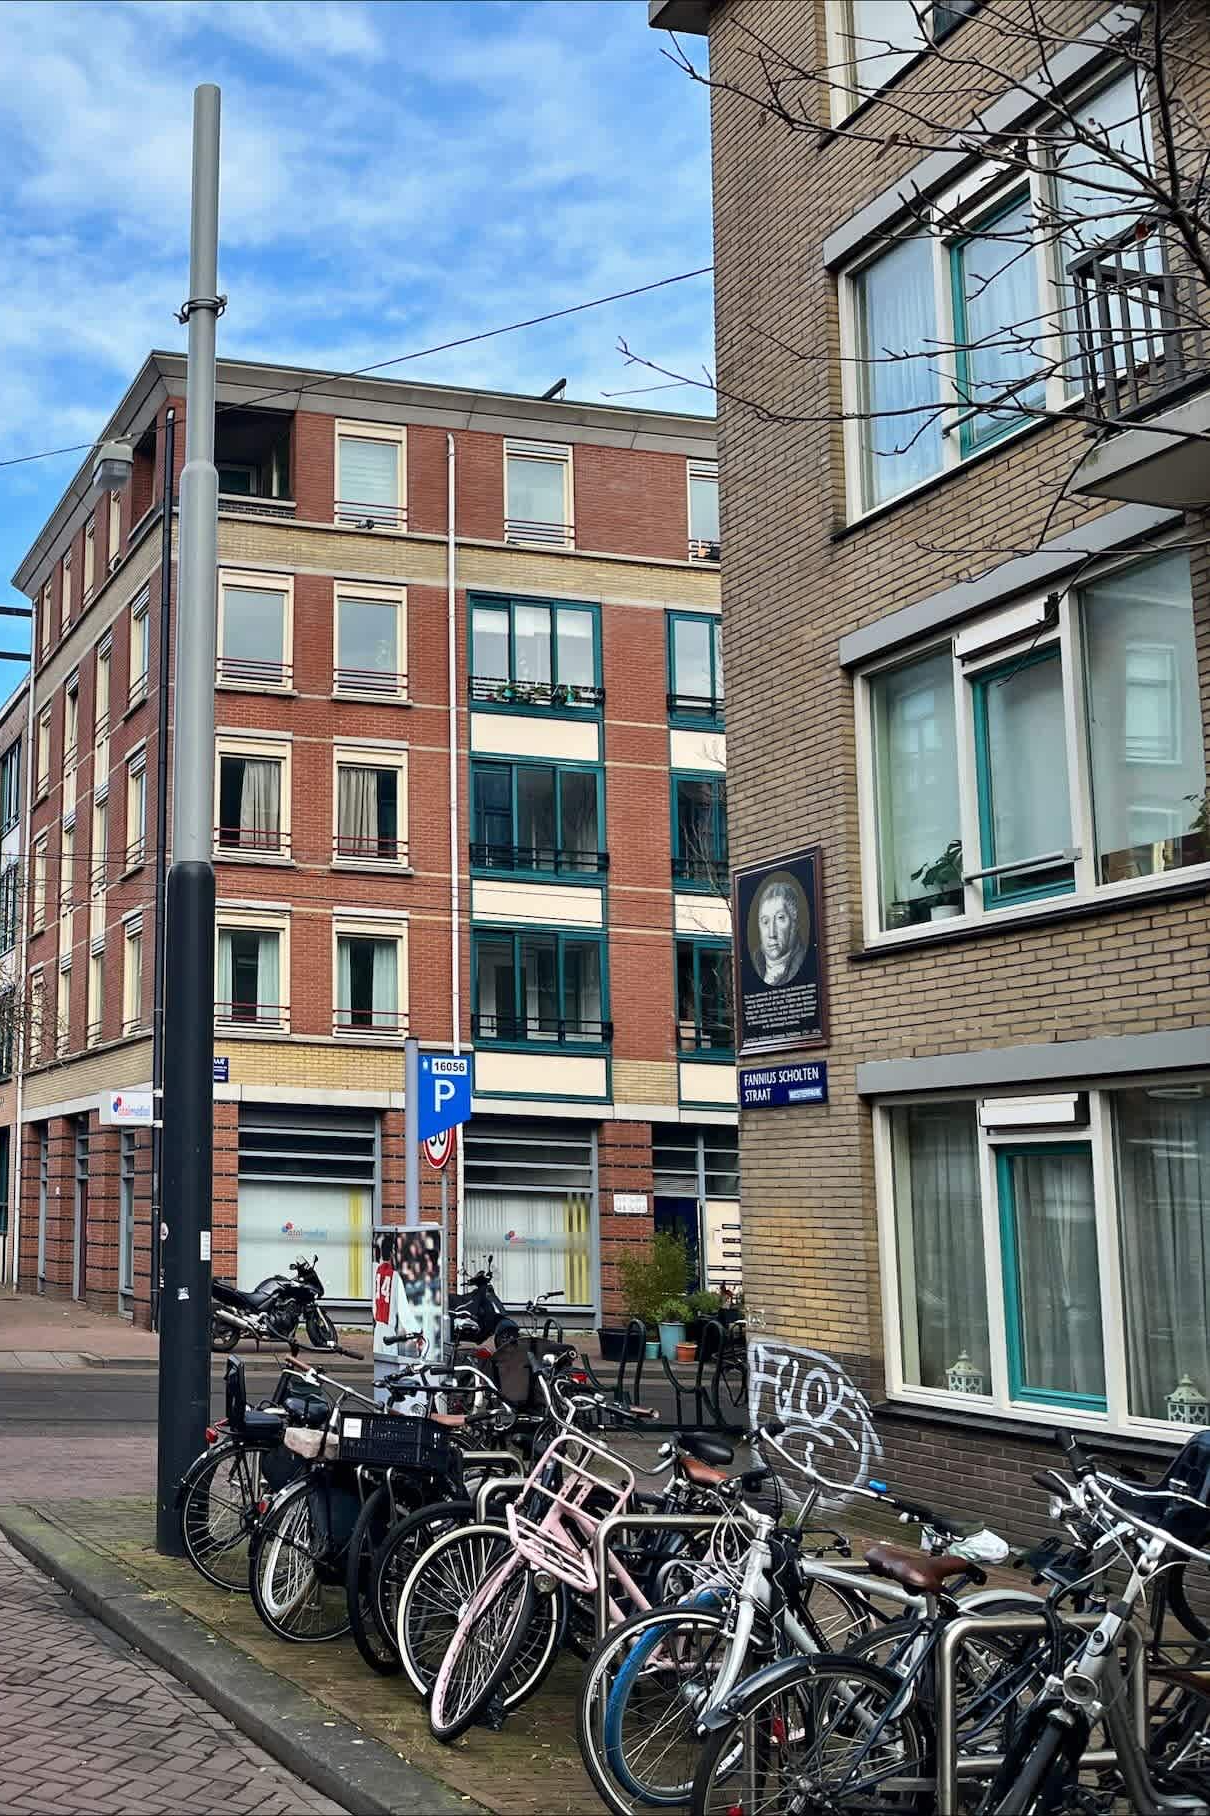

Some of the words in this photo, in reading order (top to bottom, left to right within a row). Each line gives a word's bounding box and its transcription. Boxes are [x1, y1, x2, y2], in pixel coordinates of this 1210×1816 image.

[433, 1061, 466, 1072] 16056
[744, 1071, 777, 1087] FANNIUS
[778, 1066, 820, 1083] SCHOLTEN
[434, 1079, 456, 1113] P
[744, 1087, 772, 1103] STRAAT
[375, 1272, 391, 1304] 14
